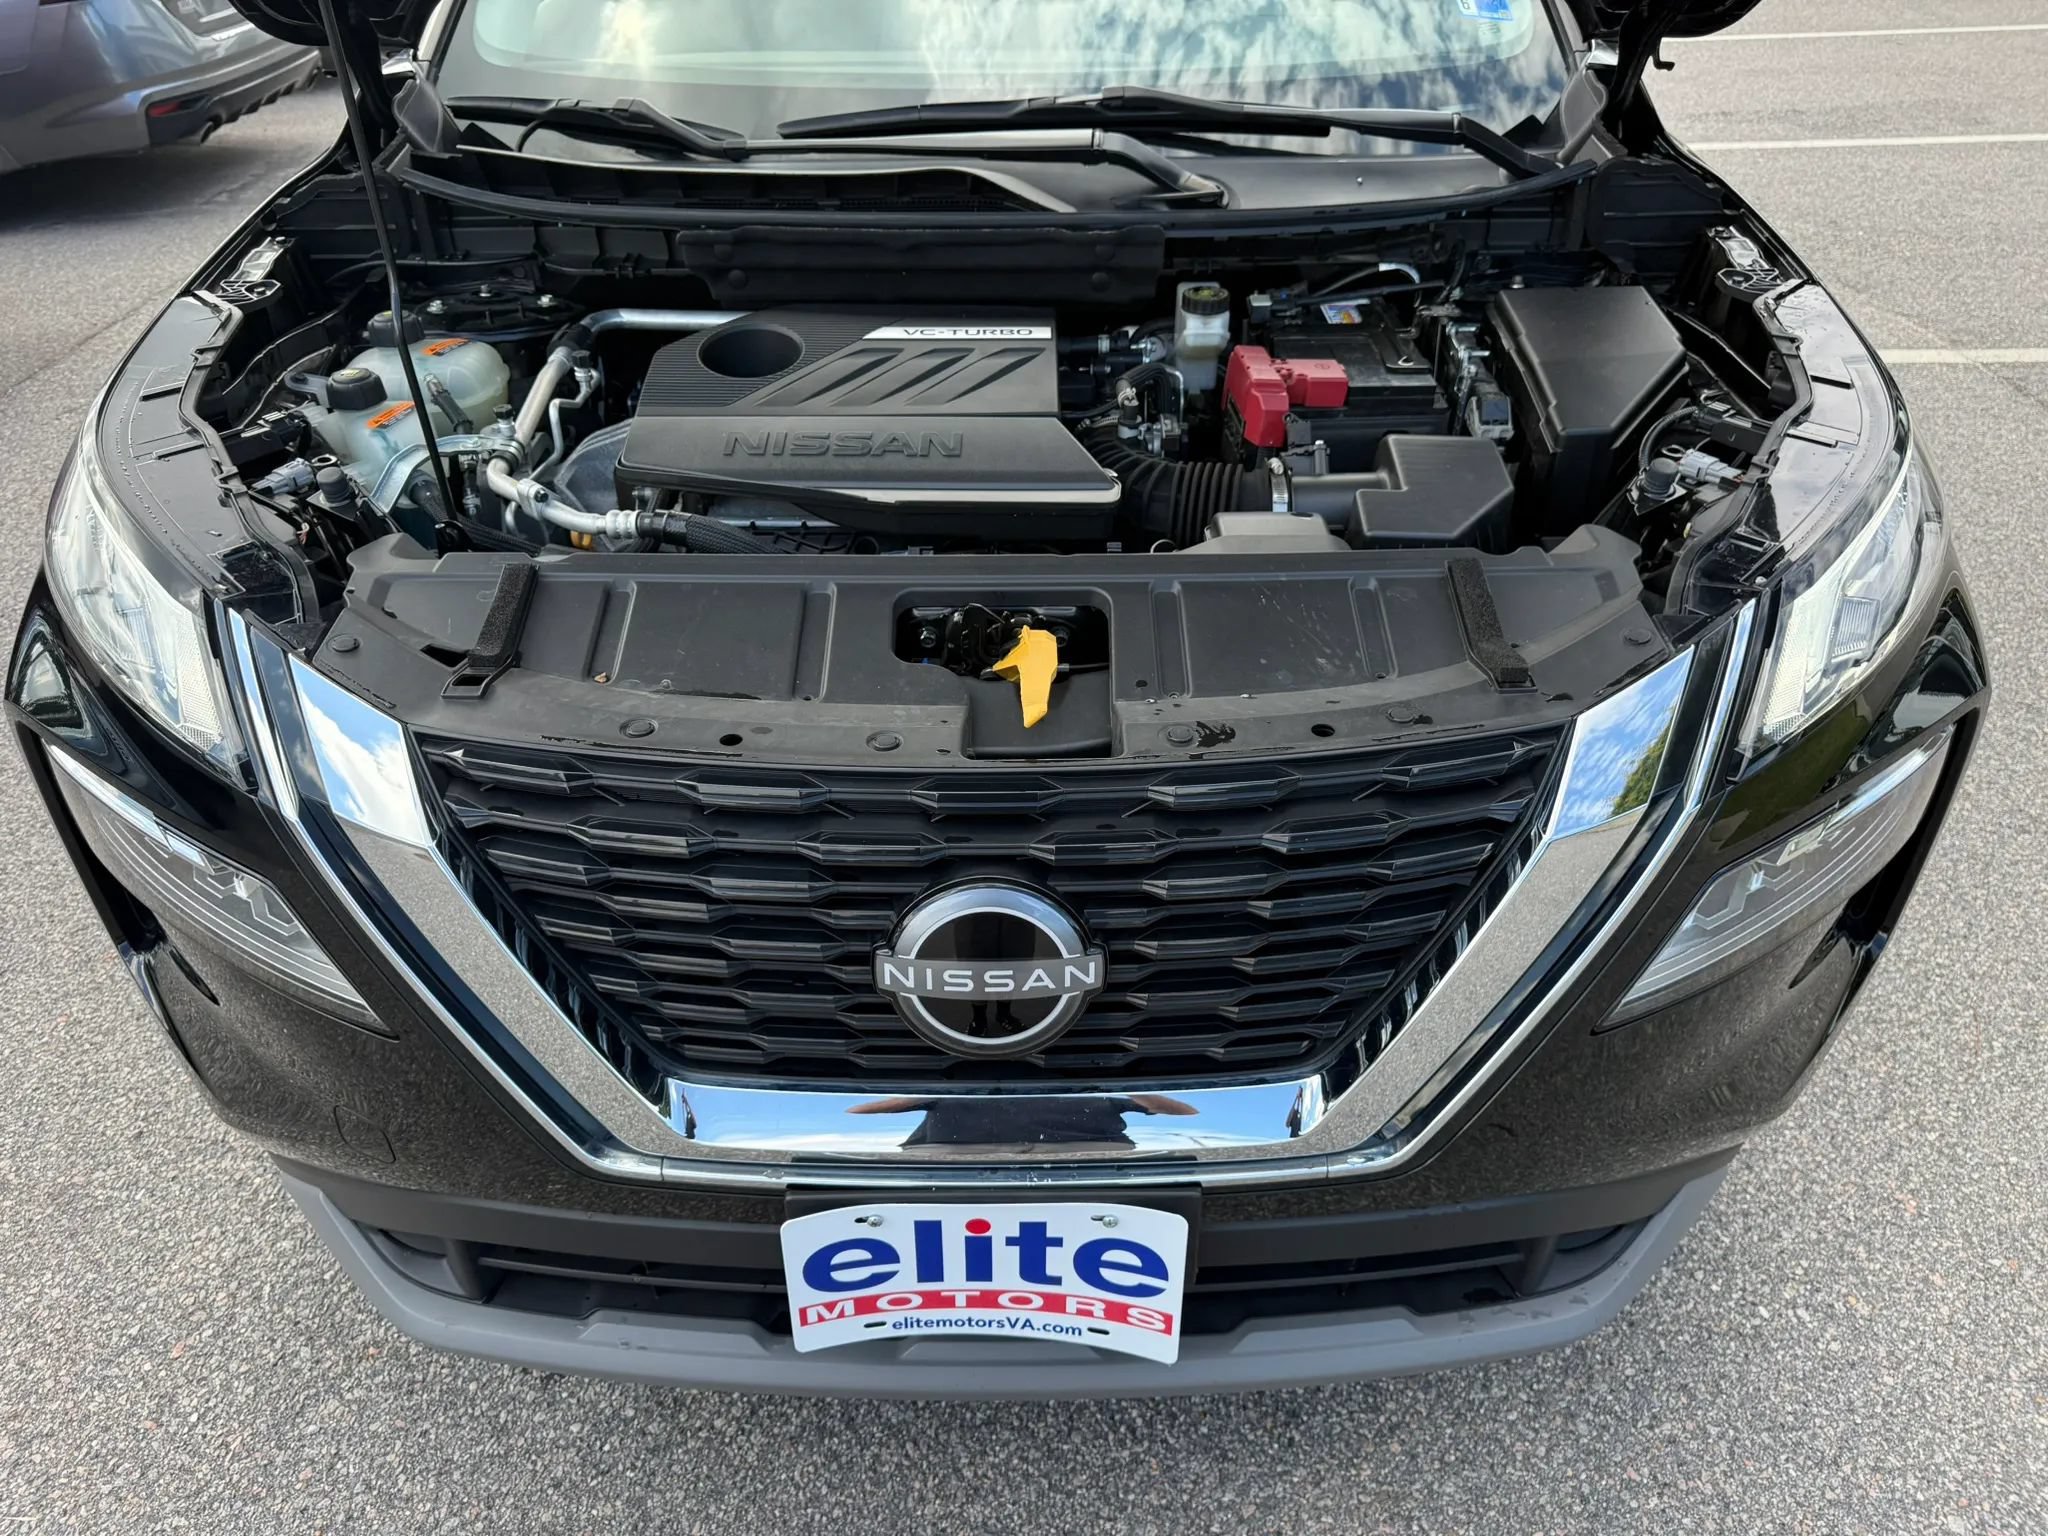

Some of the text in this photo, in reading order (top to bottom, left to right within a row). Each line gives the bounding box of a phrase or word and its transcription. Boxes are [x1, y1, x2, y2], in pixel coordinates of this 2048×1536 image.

[903, 328, 1033, 337] VC-TURBO
[723, 431, 963, 457] NISSAN
[883, 961, 1096, 993] NISSAN
[802, 1217, 1170, 1298] elite
[806, 1290, 1167, 1332] MOTORS
[892, 1316, 1082, 1337] elitemotorsVA.com
